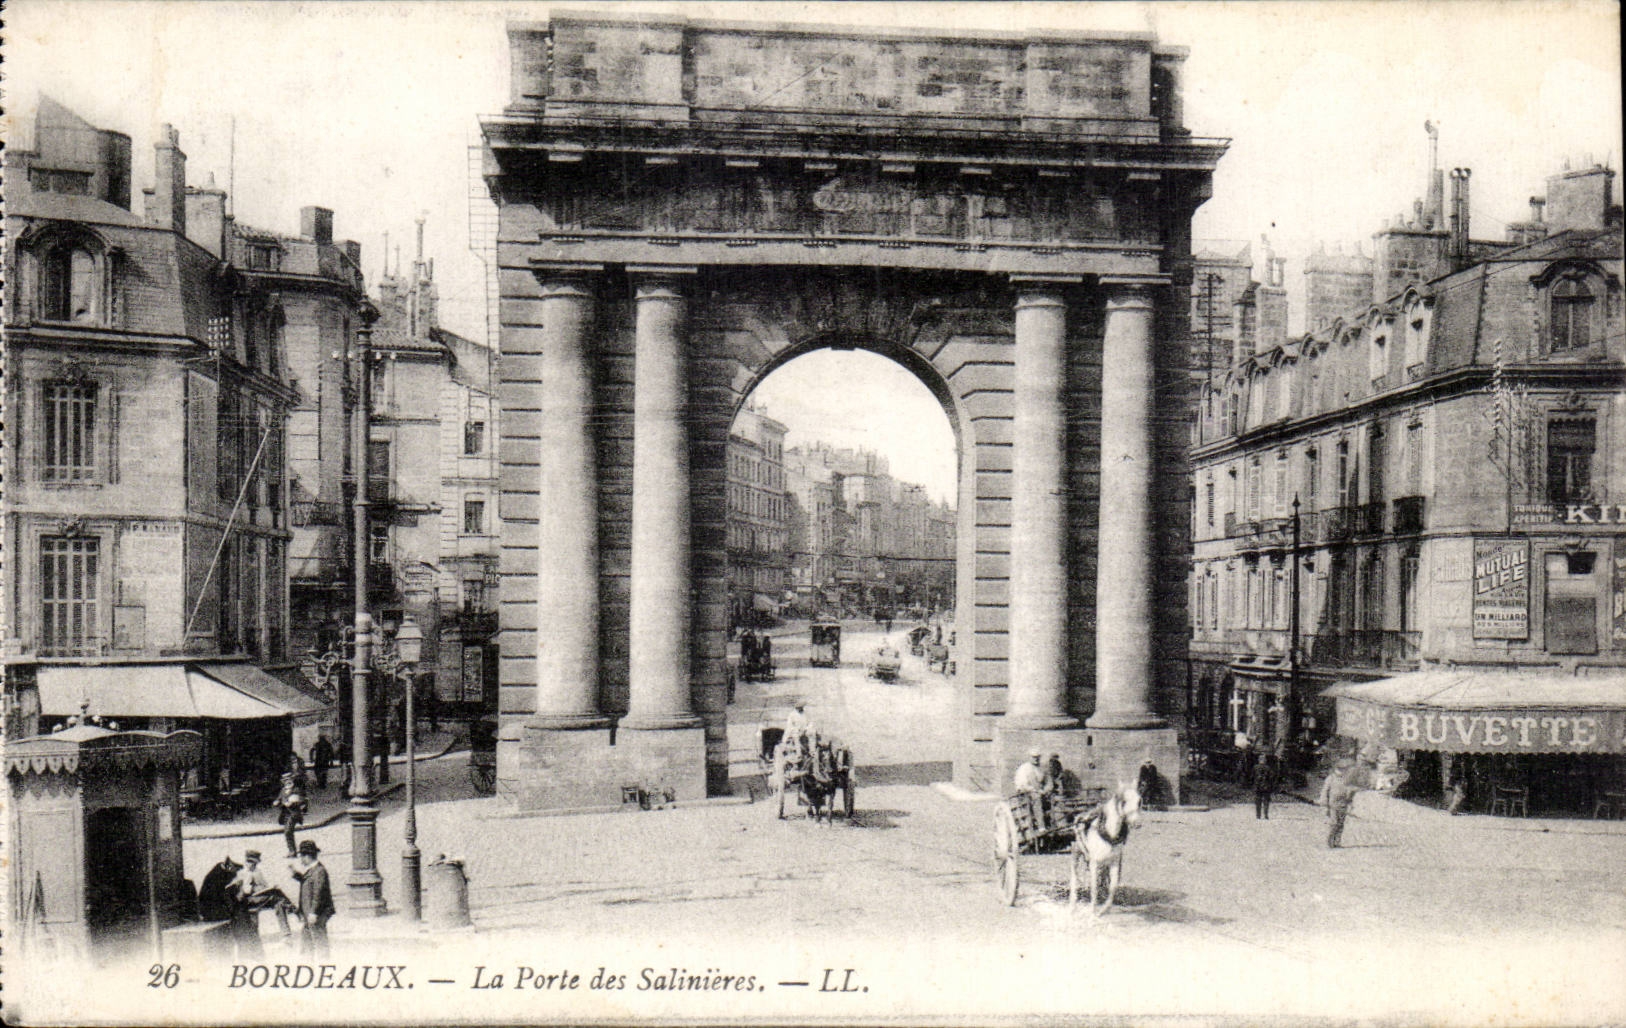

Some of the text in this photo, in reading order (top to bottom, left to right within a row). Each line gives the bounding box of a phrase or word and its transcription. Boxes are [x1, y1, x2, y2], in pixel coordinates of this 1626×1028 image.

[1475, 549, 1528, 579] MUTUAL
[1477, 564, 1525, 595] LIFE
[1488, 613, 1527, 621] MILLIARD
[1399, 712, 1598, 747] BUVETTE
